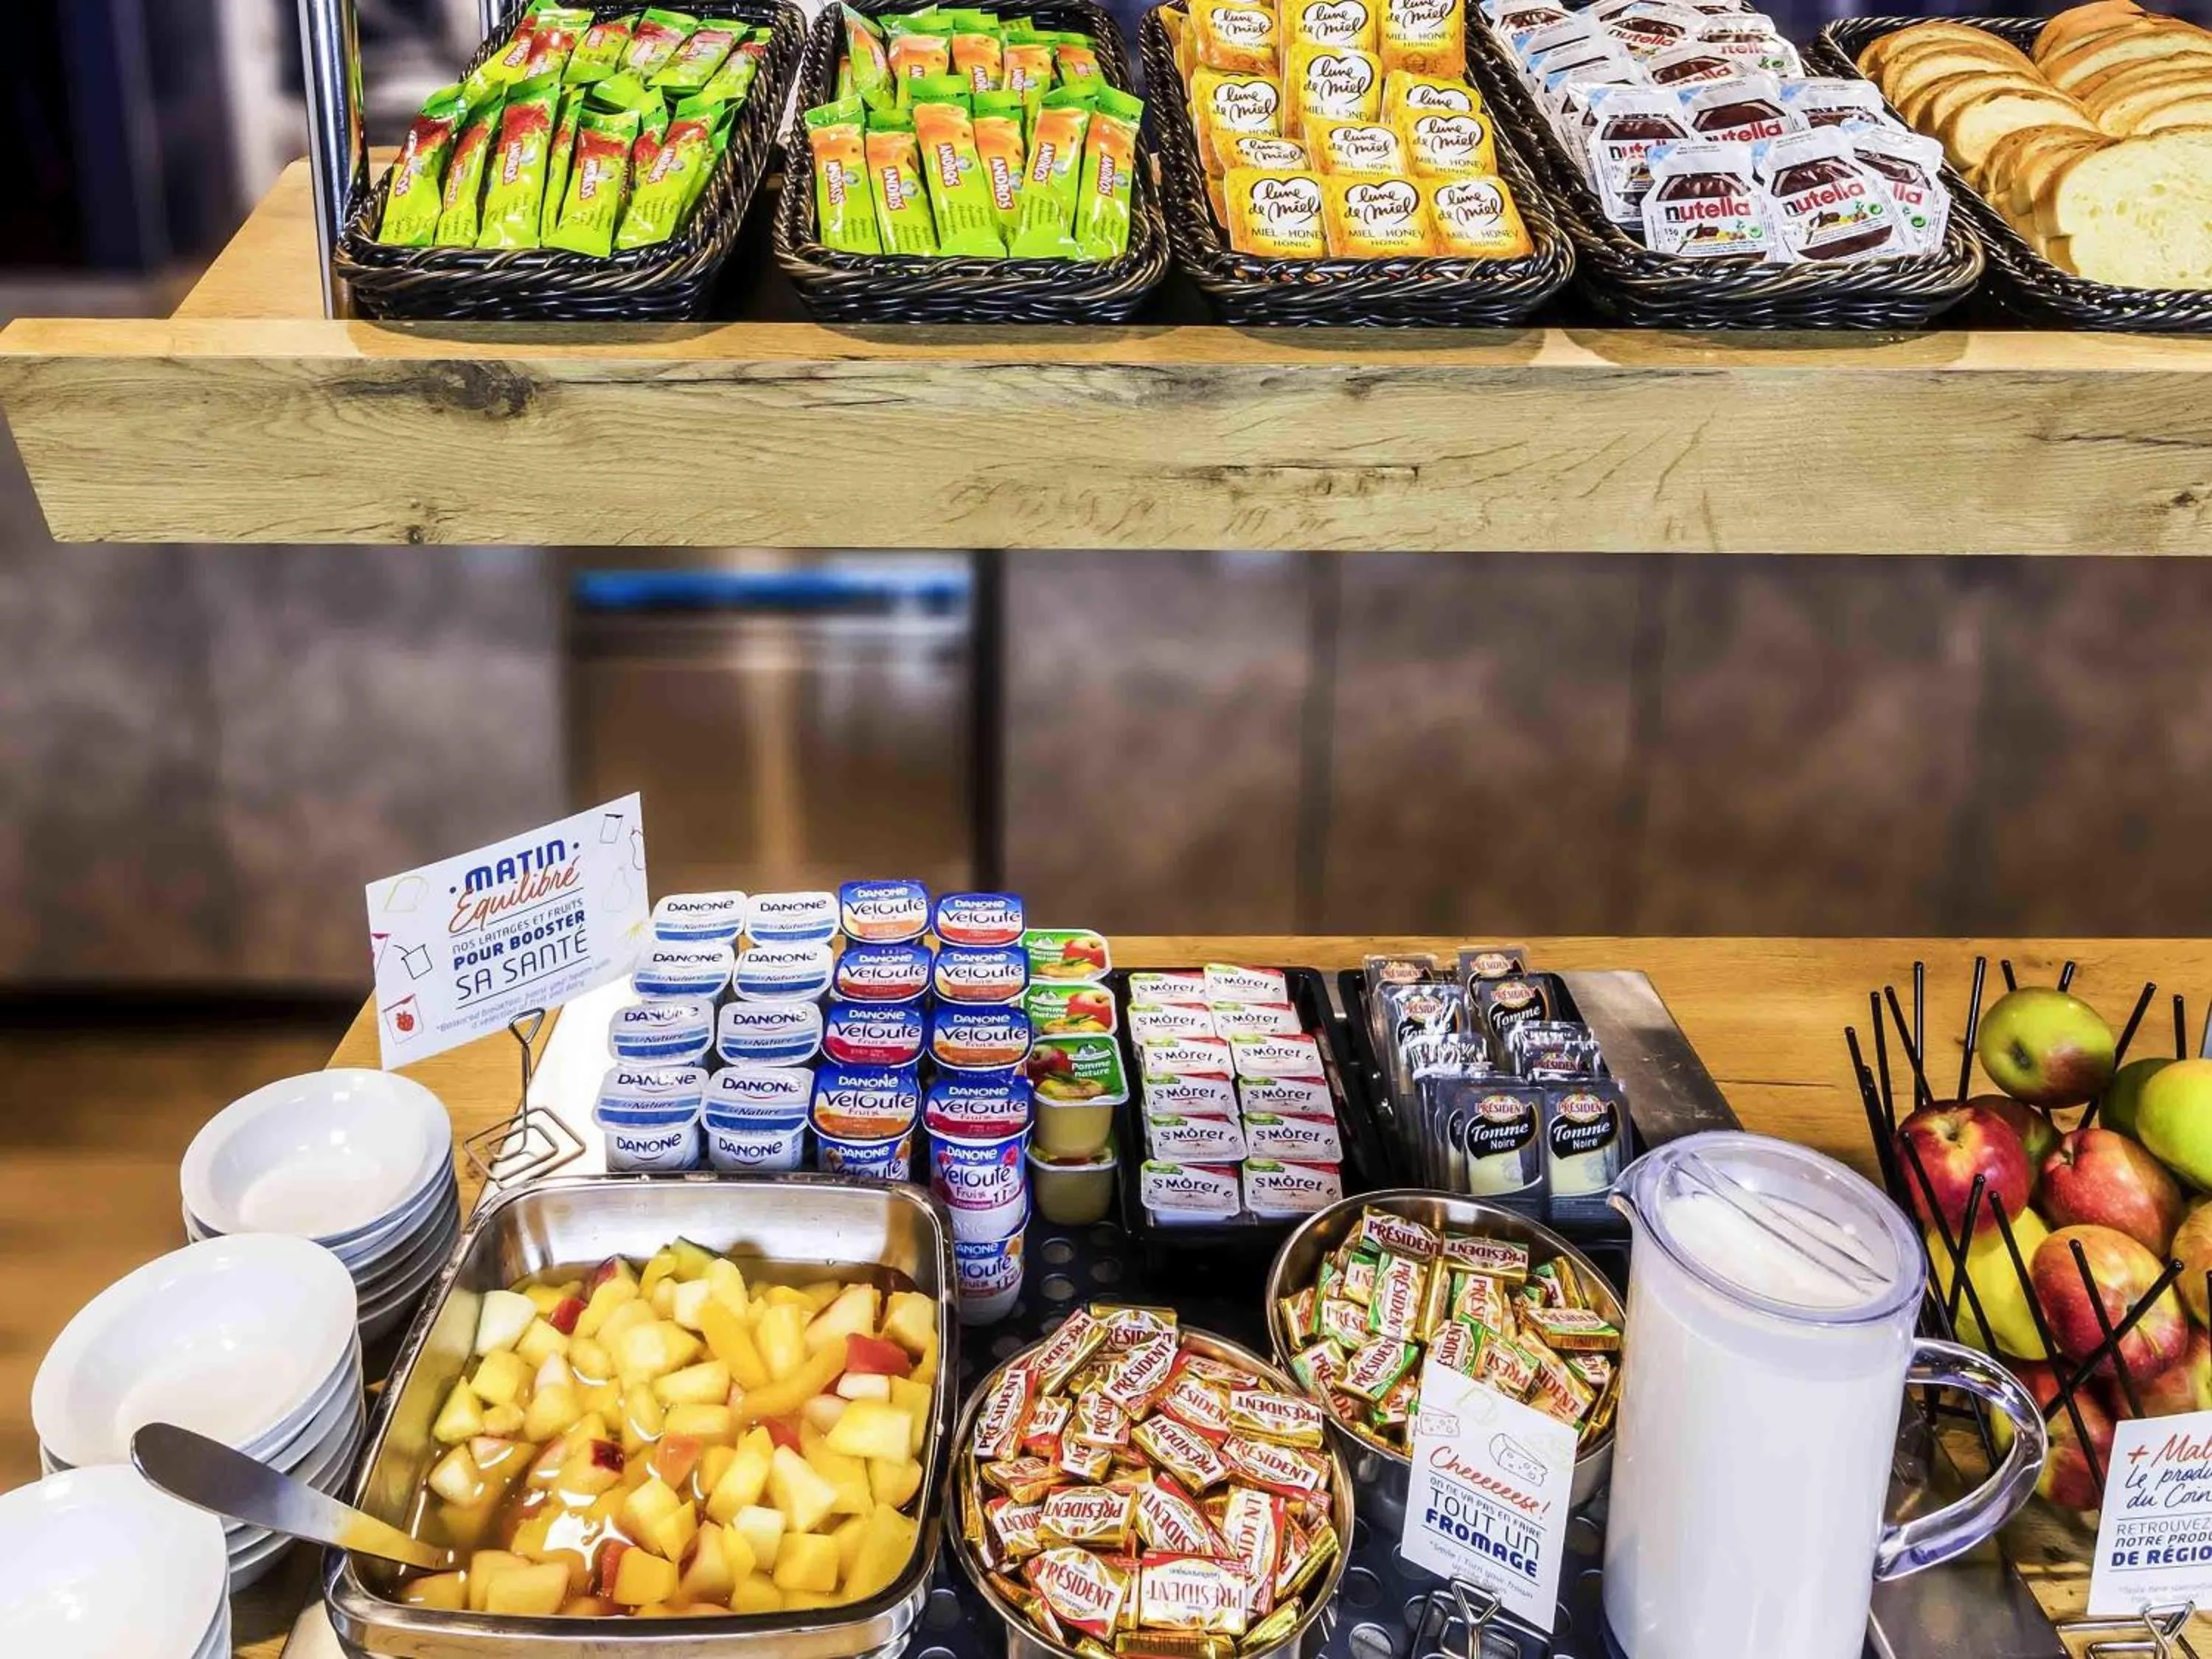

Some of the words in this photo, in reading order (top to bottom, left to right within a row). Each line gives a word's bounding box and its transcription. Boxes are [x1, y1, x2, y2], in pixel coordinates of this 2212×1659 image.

[1314, 6, 1349, 20] lune
[1316, 18, 1360, 40] miel
[1607, 27, 1676, 47] nutella
[1319, 55, 1354, 77] lune
[1225, 87, 1262, 102] lune
[1321, 77, 1366, 100] miel
[1416, 89, 1455, 109] lune
[1230, 102, 1272, 124] miel
[1426, 119, 1467, 134] lune
[1430, 133, 1478, 153] miel
[990, 157, 1014, 209] ANDROS
[1262, 183, 1305, 200] lune
[1357, 187, 1401, 203] lune
[1444, 187, 1487, 206] lune
[1782, 181, 1867, 217] nutella
[1248, 204, 1265, 216] de
[1267, 197, 1317, 223] miel
[1344, 206, 1360, 219] de
[1364, 198, 1411, 224] miel
[1456, 198, 1498, 226] miel
[1666, 196, 1752, 222] nutella
[1252, 228, 1278, 237] MIEL
[1349, 229, 1376, 238] MIEL
[1385, 229, 1425, 240] HONEY
[465, 840, 566, 891] MATIN
[858, 888, 908, 898] DANONE
[667, 899, 735, 913] DANONE
[760, 899, 827, 913] DANONE
[955, 900, 1006, 908] DANONE
[479, 922, 530, 945] LAITAGES
[533, 914, 544, 925] ET
[548, 897, 583, 919] FRUITS
[453, 942, 504, 971] POUR
[510, 910, 585, 950] BOOSTER
[456, 969, 492, 1001] SA
[502, 925, 588, 984] SANTÉ
[653, 953, 723, 963] DANONE
[859, 954, 913, 962] DANONE
[953, 953, 1006, 962] DANONE
[734, 1011, 807, 1025] DANONE
[849, 1009, 906, 1020] DANONE
[953, 1014, 1011, 1024] DANONE
[1492, 1006, 1541, 1030] Tomme
[1072, 1060, 1111, 1070] Pomme
[1074, 1068, 1110, 1078] nature
[838, 1074, 899, 1088] DANONE
[949, 1086, 1009, 1096] DANONE
[1471, 1122, 1529, 1143] Tomme
[1554, 1121, 1610, 1142] Tomme
[616, 1133, 682, 1153] DANONE
[719, 1137, 783, 1157] DANONE
[838, 1146, 890, 1159] DANONE
[947, 1145, 998, 1160] DANONE
[1490, 1138, 1515, 1150] Noire
[1573, 1137, 1598, 1150] Noire
[956, 1241, 998, 1253] ANONE
[1368, 1220, 1442, 1253] PRÉSIDENT
[1450, 1242, 1526, 1263] PRÉSIDENT
[1389, 1262, 1411, 1339] PRÉSIDENT
[1111, 1341, 1172, 1396] PRÉSIDENT
[1352, 1335, 1398, 1388] PRÉSIDENT
[979, 1372, 1021, 1449] PRÉSIDENT
[1235, 1395, 1321, 1423] PRÉSIDENT
[1149, 1419, 1217, 1475] PRÉSIDENT
[1227, 1435, 1312, 1483] PRÉSIDENT
[2125, 1464, 2148, 1489] Le
[2154, 1461, 2212, 1491] produ
[2126, 1489, 2157, 1509] du
[2164, 1483, 2212, 1508] Coin
[1042, 1499, 1124, 1520] PRÉSIDENT
[1430, 1476, 1444, 1489] ON
[1446, 1484, 1458, 1495] NE
[1461, 1490, 1474, 1503] VA
[1475, 1498, 1495, 1514] PAS
[1498, 1511, 1511, 1523] EN
[1513, 1519, 1541, 1538] FAIRE
[1430, 1486, 1496, 1534] TOUT
[1505, 1525, 1540, 1560] UN
[1425, 1508, 1537, 1578] FROMAGE
[2115, 1534, 2165, 1548] NOTRE
[2111, 1551, 2139, 1567] DE
[2146, 1544, 2212, 1565] RÉGIO
[1042, 1557, 1115, 1610] PRÉSIDENT
[1148, 1579, 1245, 1610] PRÉSIDENT
